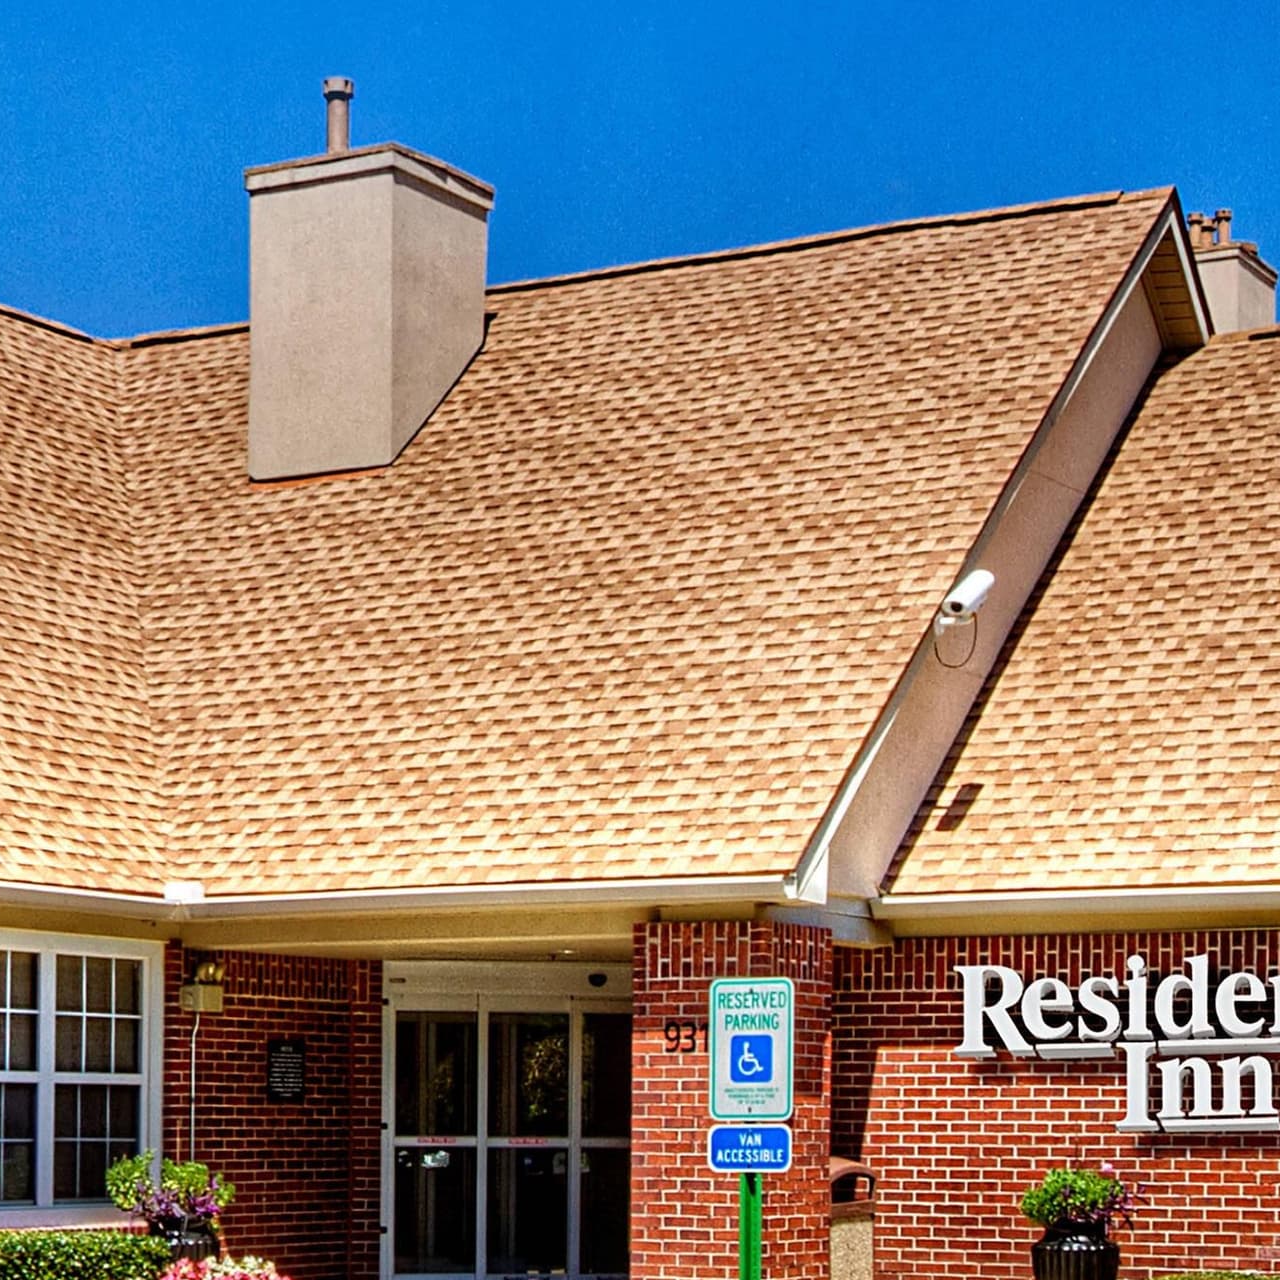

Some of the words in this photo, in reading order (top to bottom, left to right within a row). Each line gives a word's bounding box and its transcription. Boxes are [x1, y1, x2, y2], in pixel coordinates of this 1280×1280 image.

[718, 991, 786, 1009] RESERVED
[724, 1013, 780, 1031] PARKING
[1116, 1041, 1280, 1132] Inn
[739, 1133, 762, 1146] VAN
[716, 1148, 784, 1163] ACCESSIBLE
